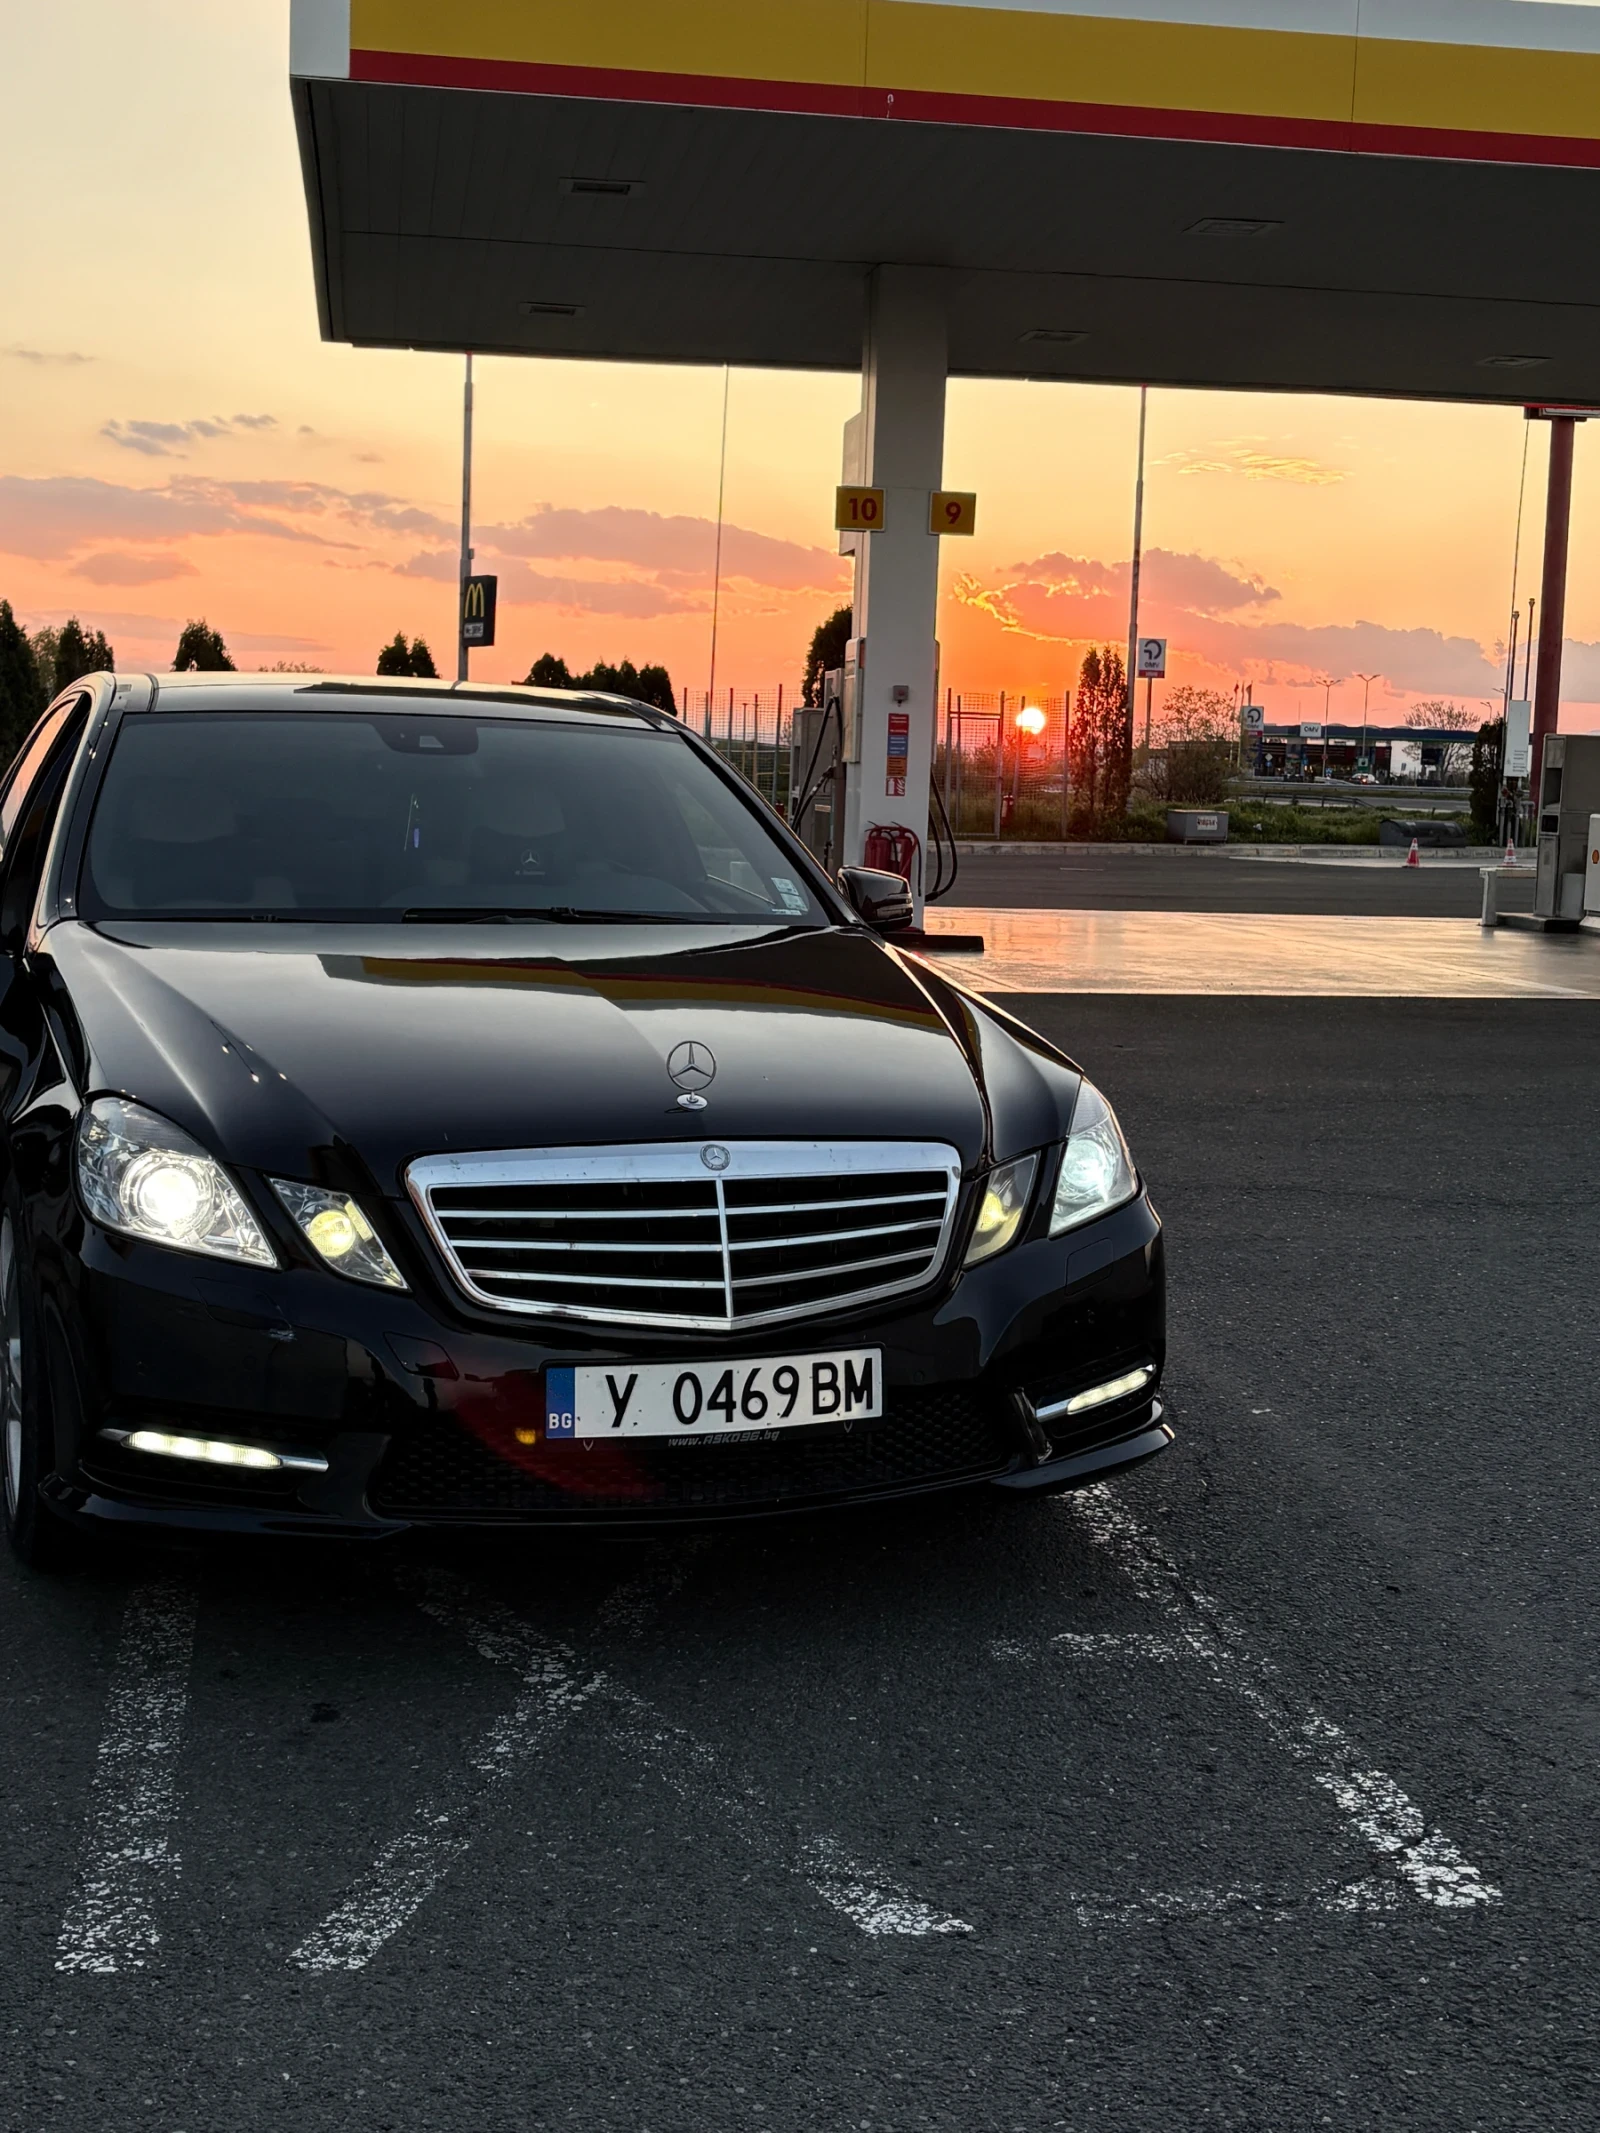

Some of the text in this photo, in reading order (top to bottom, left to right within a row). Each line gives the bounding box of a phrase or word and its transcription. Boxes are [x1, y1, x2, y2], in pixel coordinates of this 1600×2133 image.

[848, 498, 877, 521] 10
[945, 502, 962, 524] 9
[548, 1412, 572, 1430] BG
